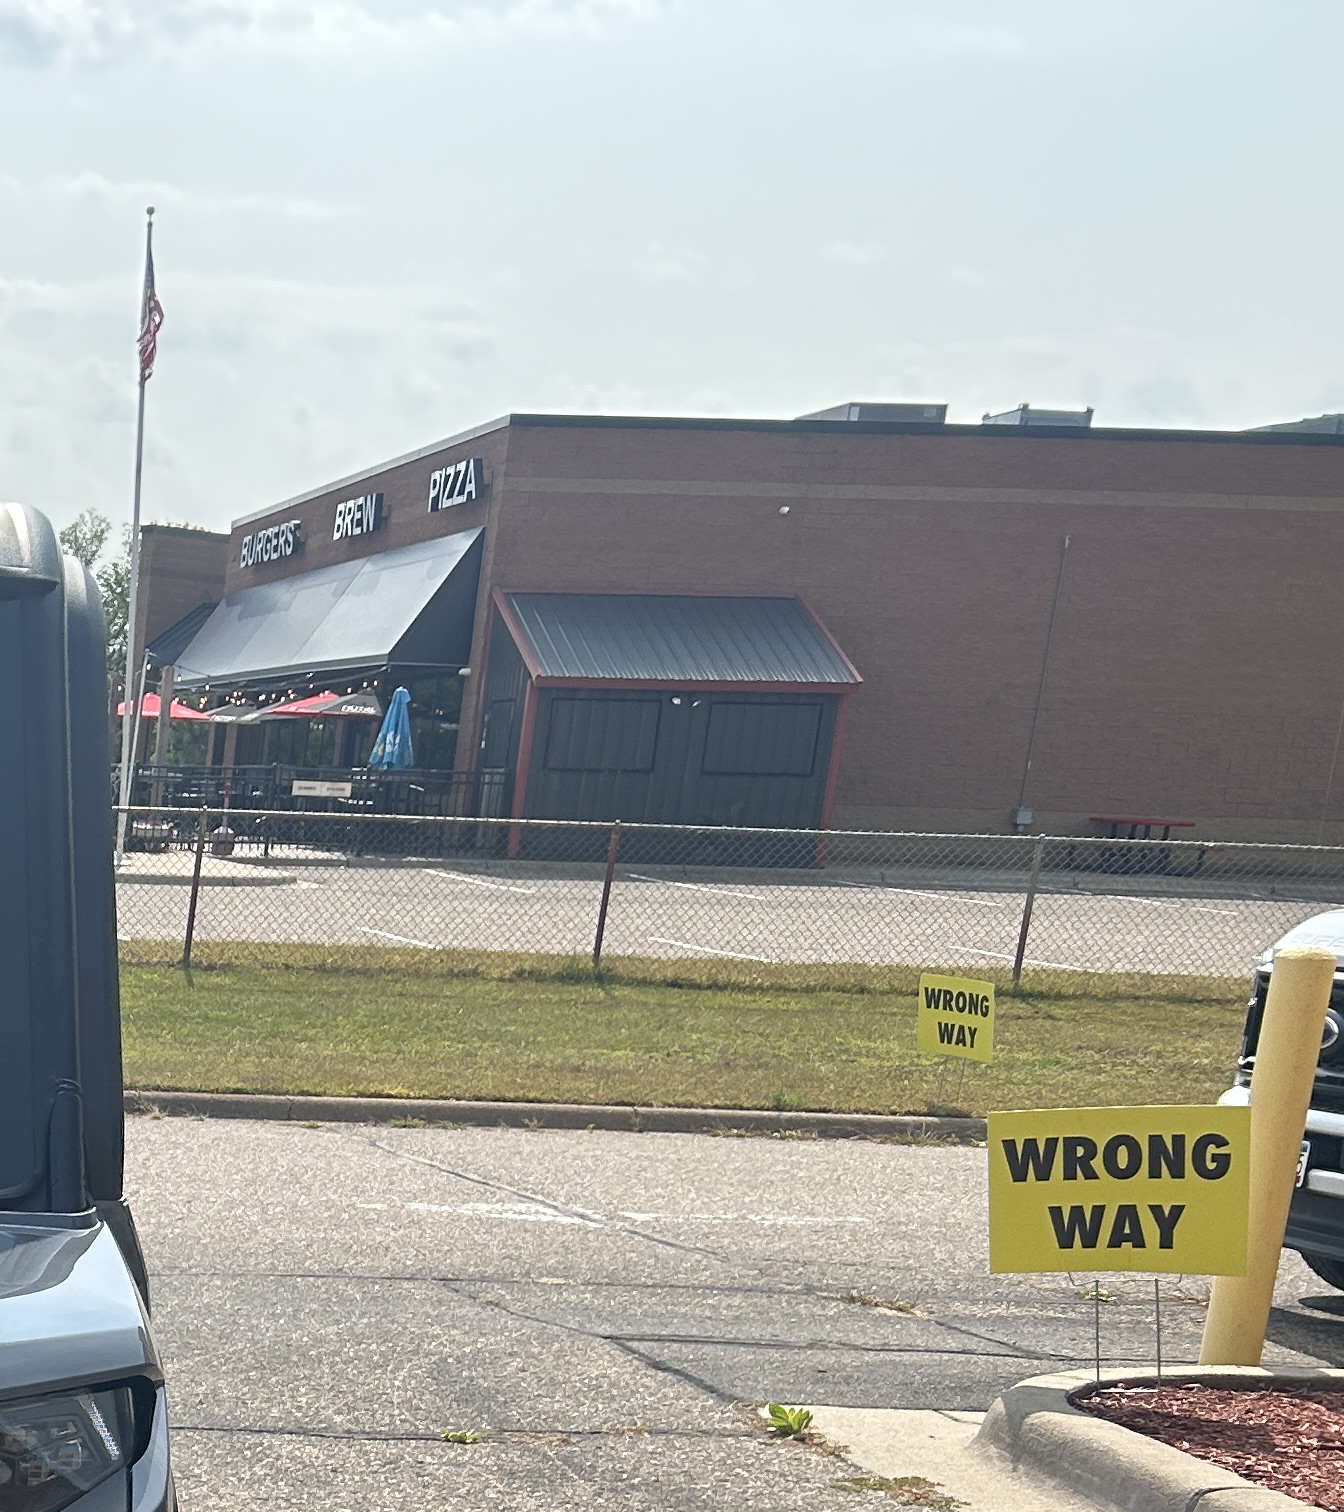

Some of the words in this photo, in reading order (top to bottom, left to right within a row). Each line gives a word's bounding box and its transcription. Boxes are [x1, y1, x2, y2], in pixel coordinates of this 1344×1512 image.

[427, 458, 477, 512] PIZZA
[332, 493, 380, 540] BREW
[240, 520, 298, 568] BURGERS
[924, 986, 990, 1018] WRONG
[937, 1021, 978, 1049] WAY
[1001, 1132, 1232, 1183] WRONG
[1047, 1203, 1186, 1250] WAY
